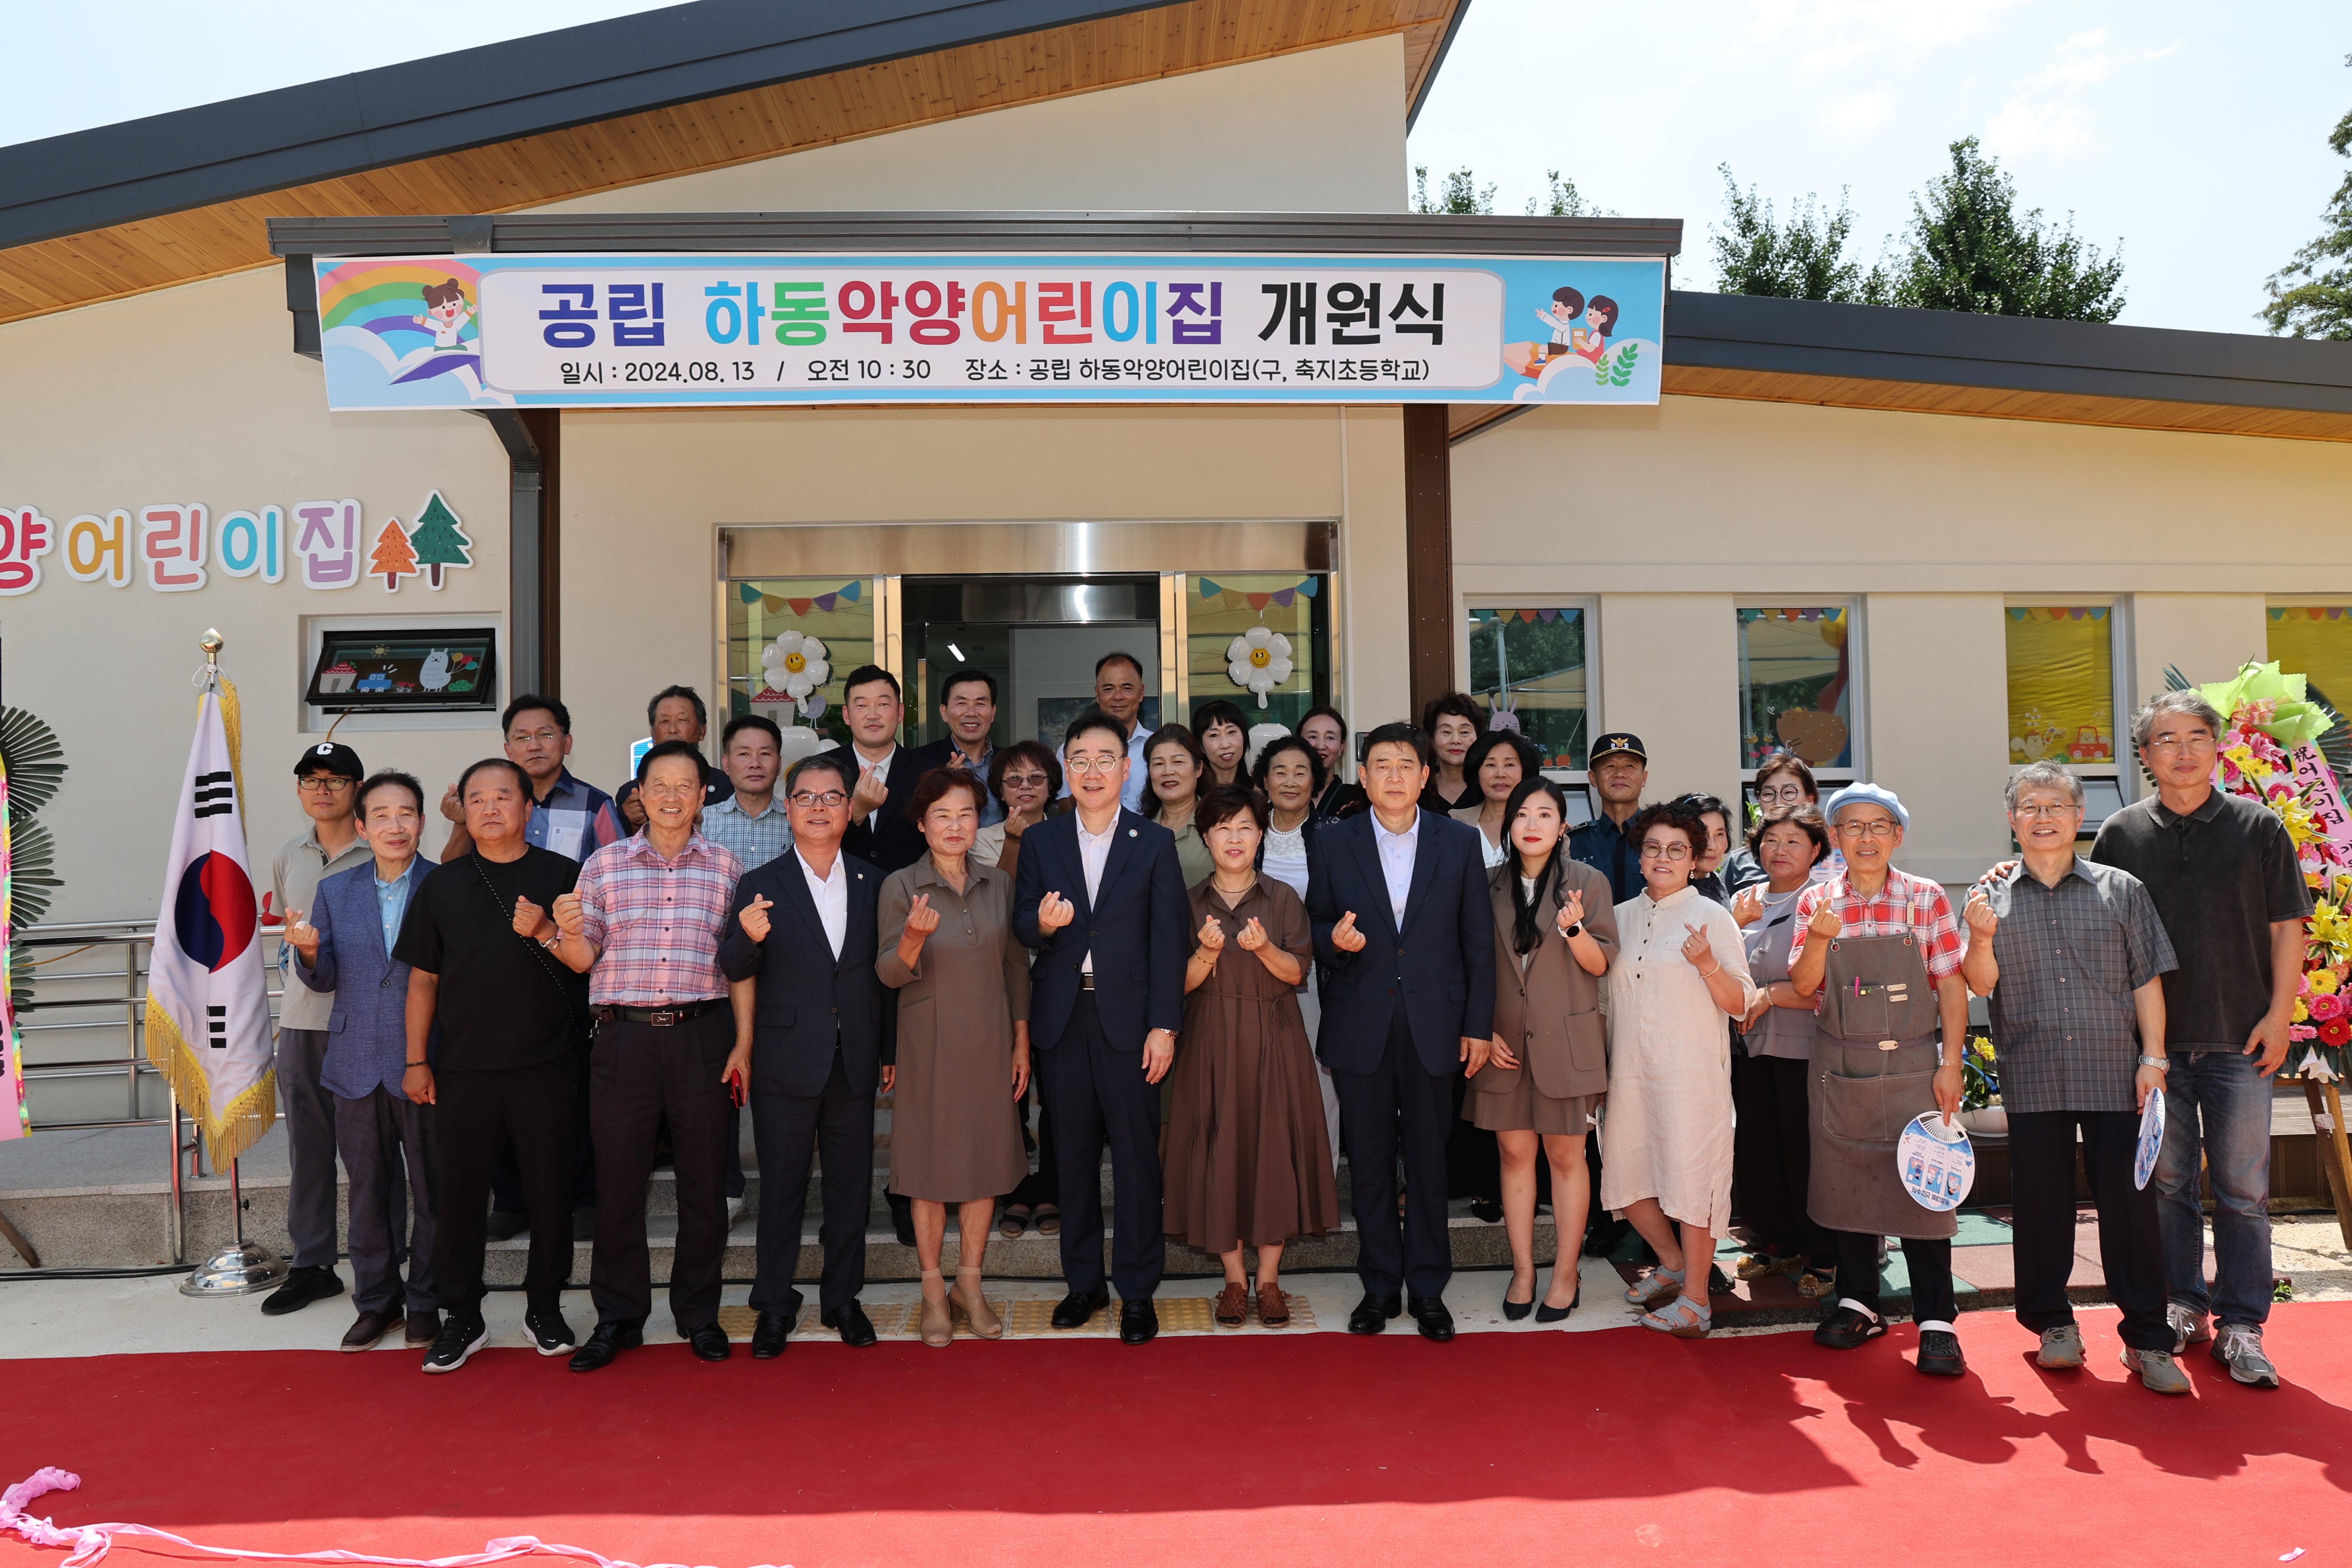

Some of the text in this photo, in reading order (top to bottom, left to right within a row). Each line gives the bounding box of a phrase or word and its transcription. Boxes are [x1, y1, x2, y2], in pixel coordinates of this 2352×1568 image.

[539, 281, 1445, 348] 공립 하동악양어린이집 개원식
[561, 362, 603, 384] 일시
[732, 361, 754, 380] 13
[808, 359, 849, 381] 오전
[965, 359, 1008, 381] 장소
[1029, 359, 1070, 381] 공립
[1295, 358, 1429, 381] 축지초등학교)
[317, 743, 334, 755] C
[2292, 746, 2318, 762] 祝
